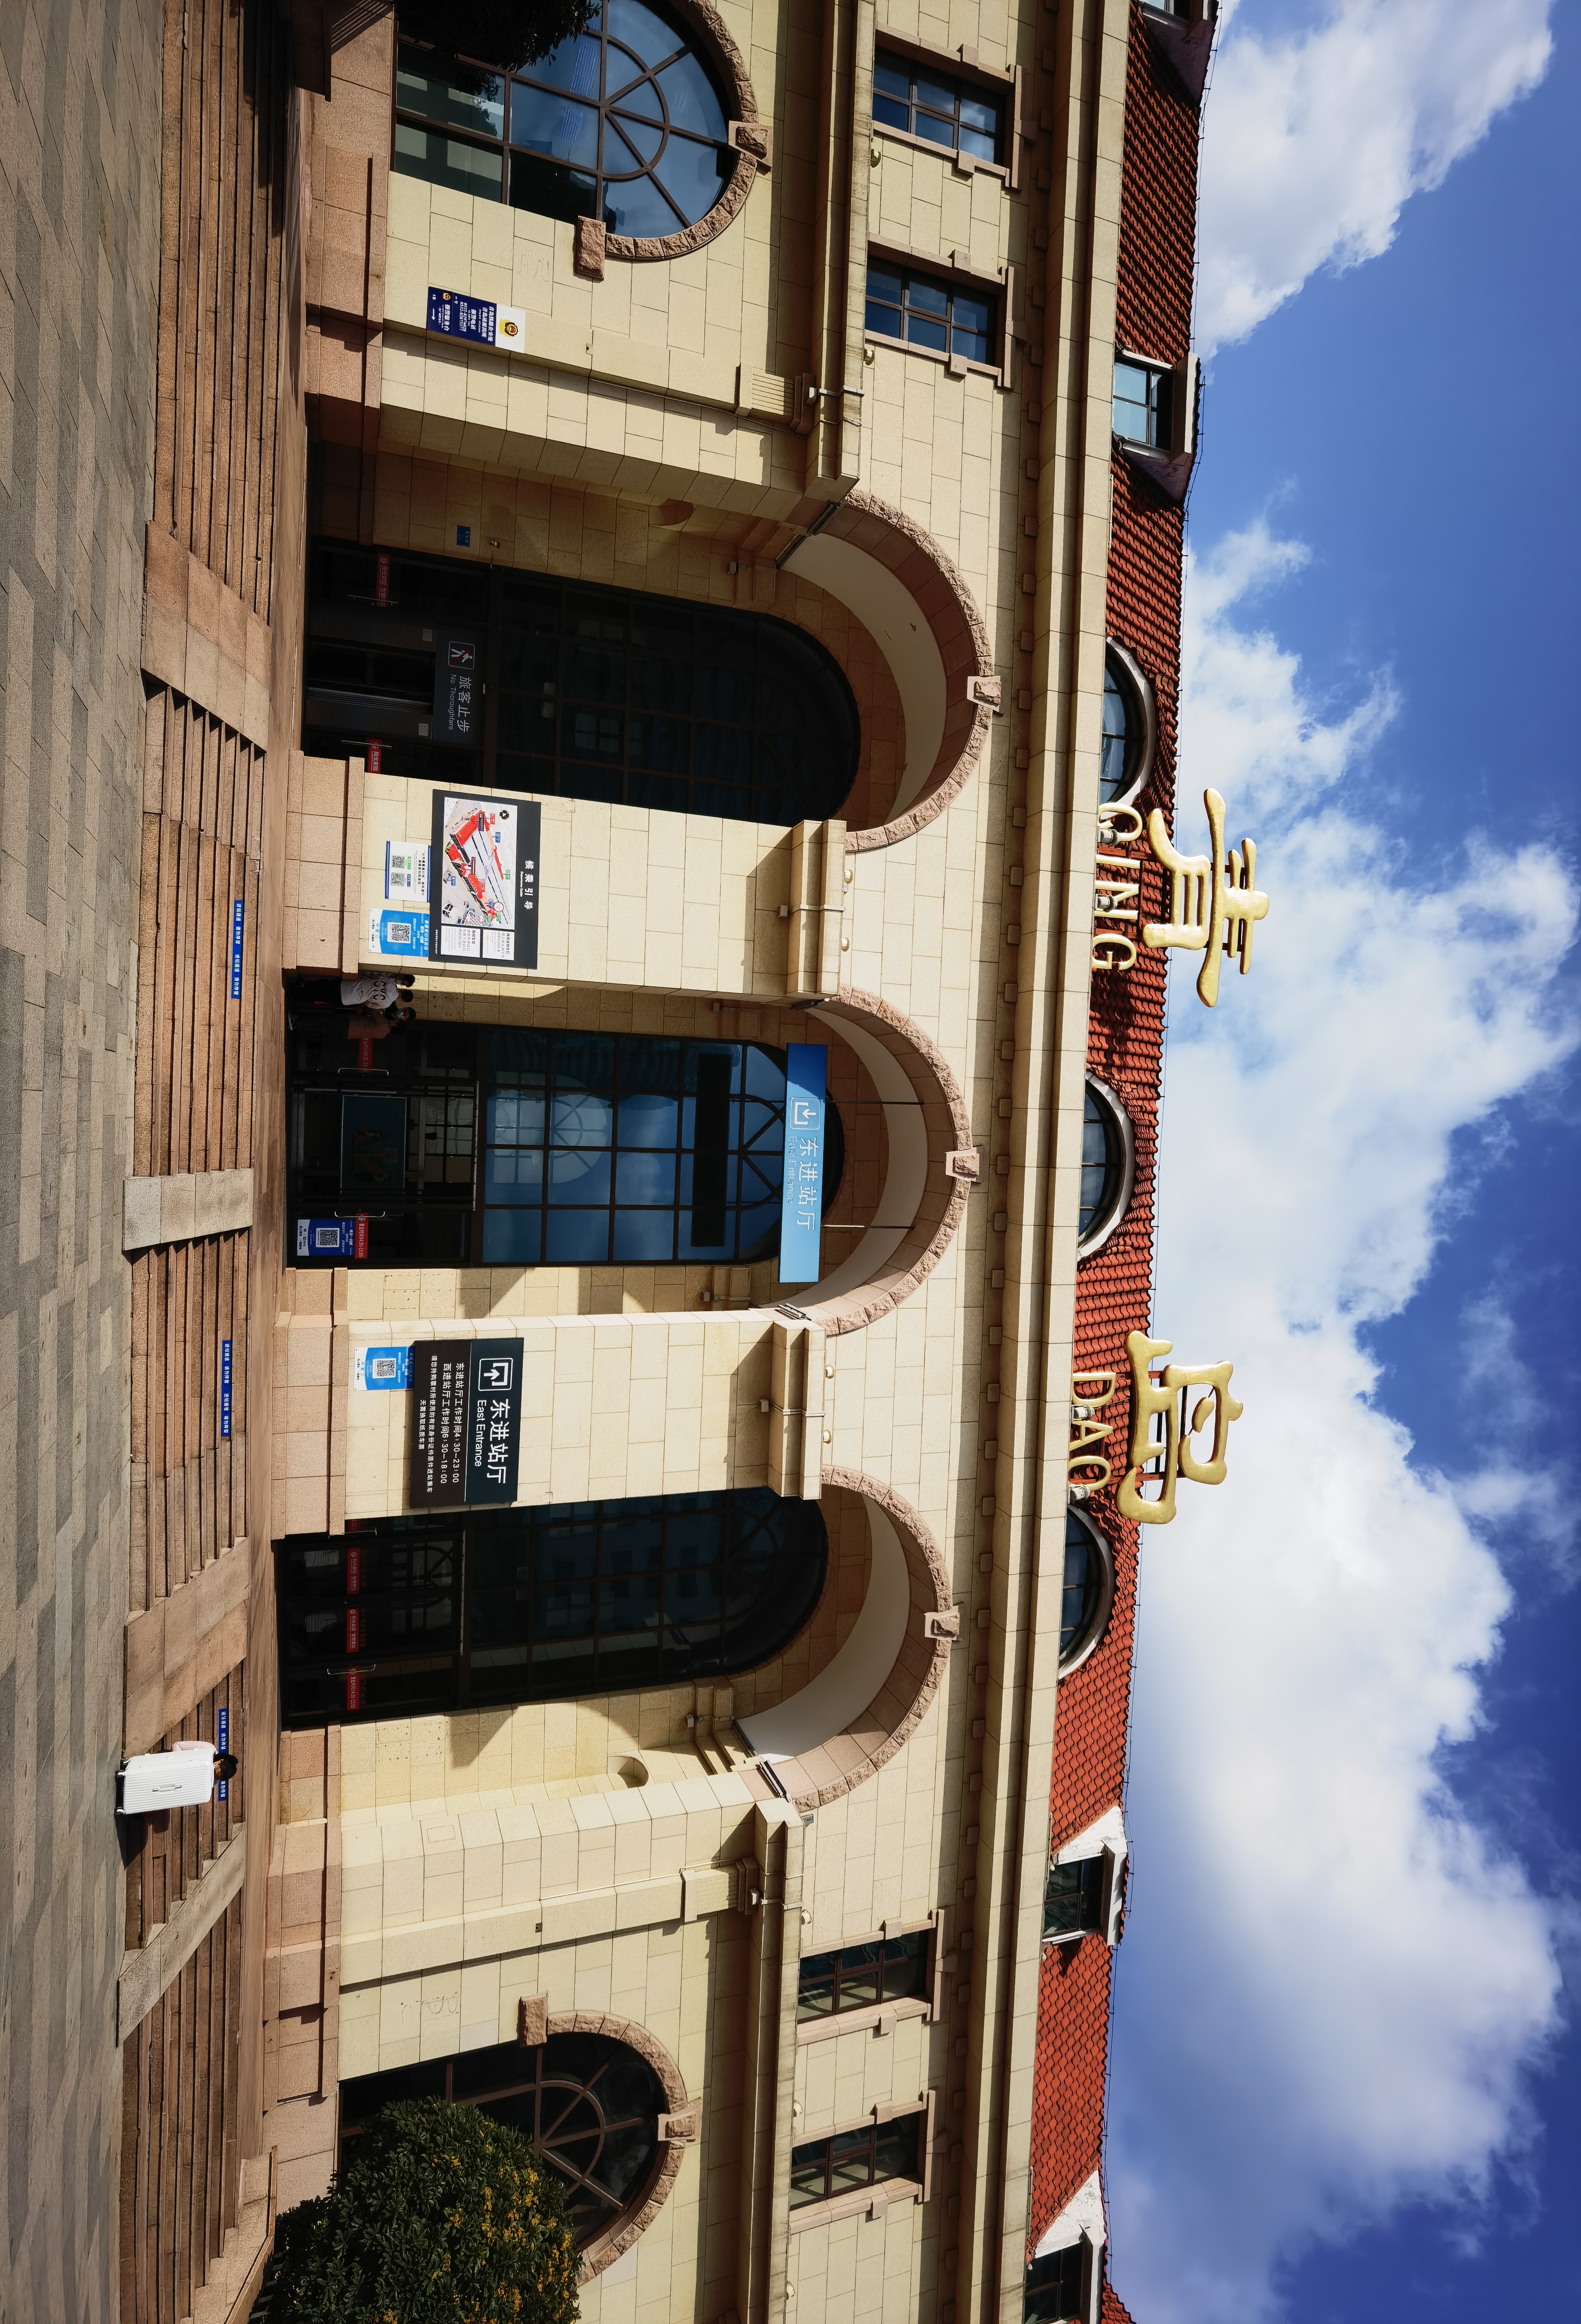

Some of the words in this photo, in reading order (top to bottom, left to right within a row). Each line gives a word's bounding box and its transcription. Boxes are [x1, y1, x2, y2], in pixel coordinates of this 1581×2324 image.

[451, 675, 457, 683] No
[457, 676, 472, 732] 旅客止步
[525, 860, 534, 910] 候乘引导
[1092, 802, 1143, 970] QING
[1143, 788, 1269, 1007] 青
[789, 1136, 797, 1157] East
[787, 1160, 797, 1204] Entrance
[797, 1138, 819, 1230] 东进站厅
[427, 1355, 438, 1493] 请您持购票时所使用的有效身份证件原件进站乘车
[475, 1424, 485, 1467] Entrance
[476, 1400, 486, 1421] East
[487, 1399, 510, 1483] 东进站厅
[1068, 1373, 1117, 1491] DAO
[1115, 1330, 1243, 1524] 岛
